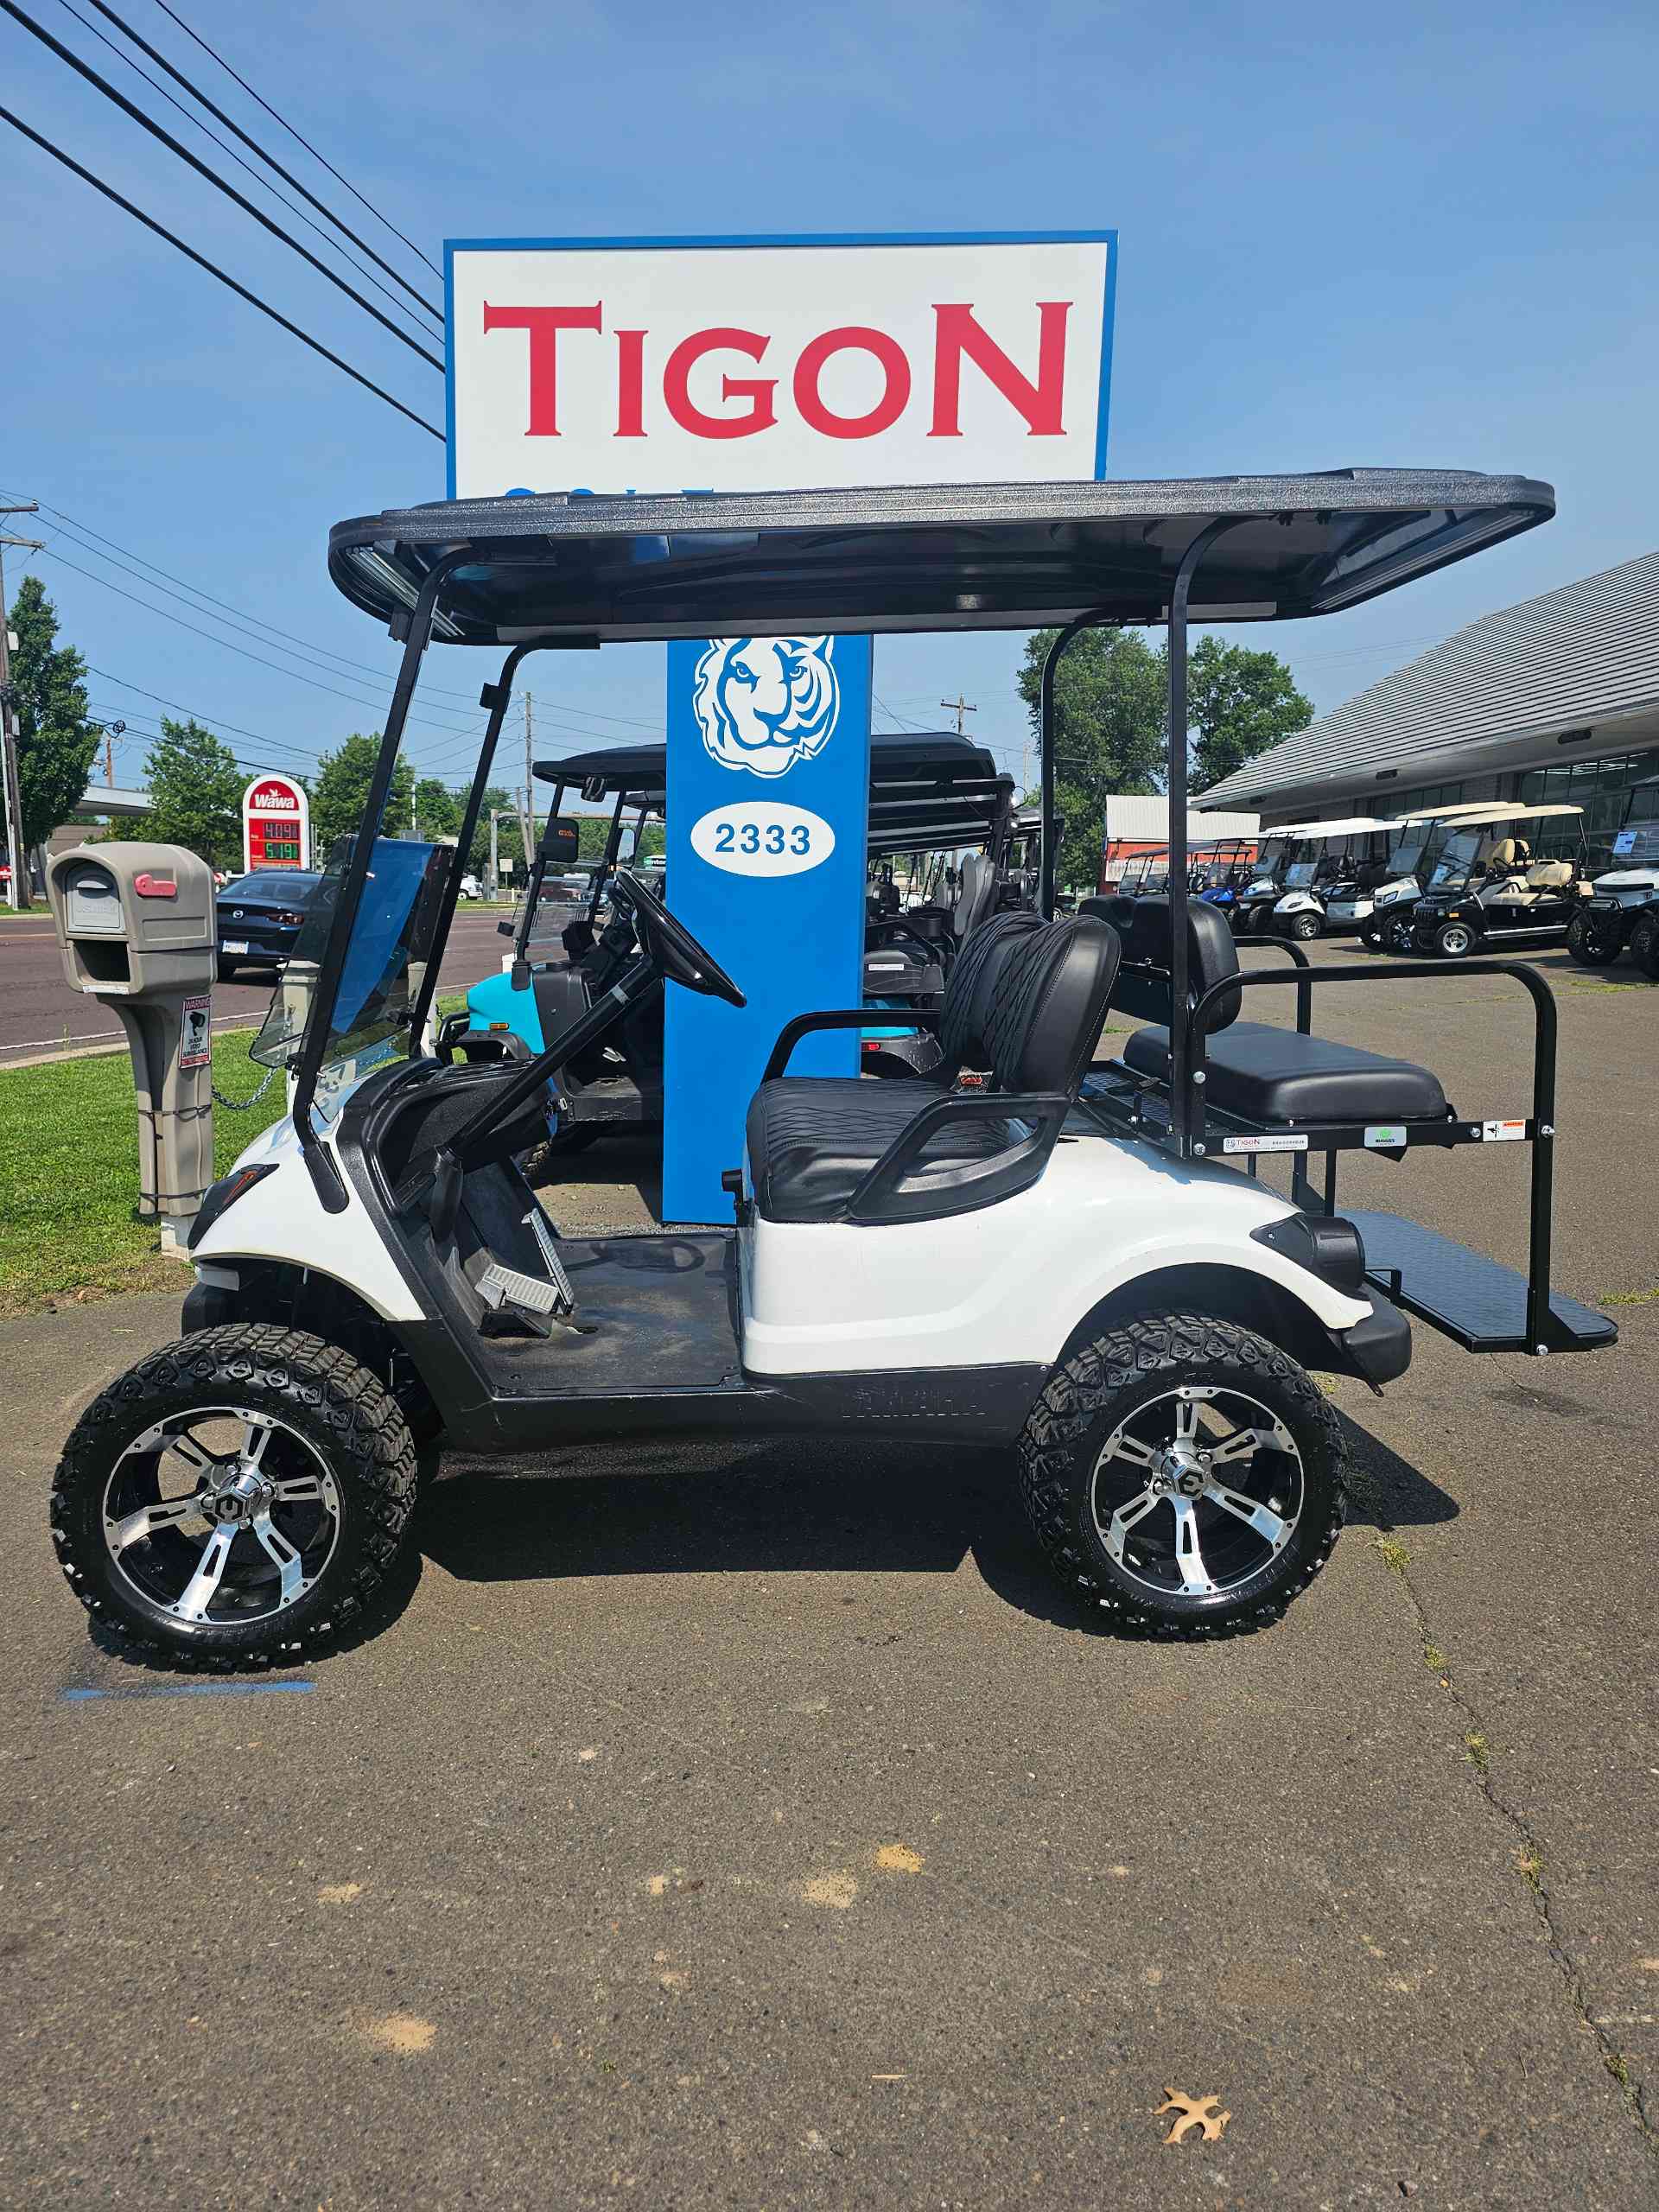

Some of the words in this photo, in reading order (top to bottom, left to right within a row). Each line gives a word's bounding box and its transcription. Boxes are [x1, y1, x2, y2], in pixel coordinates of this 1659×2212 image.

[484, 300, 1074, 439] TIGON
[254, 794, 295, 809] Wawa
[715, 823, 810, 855] 2333
